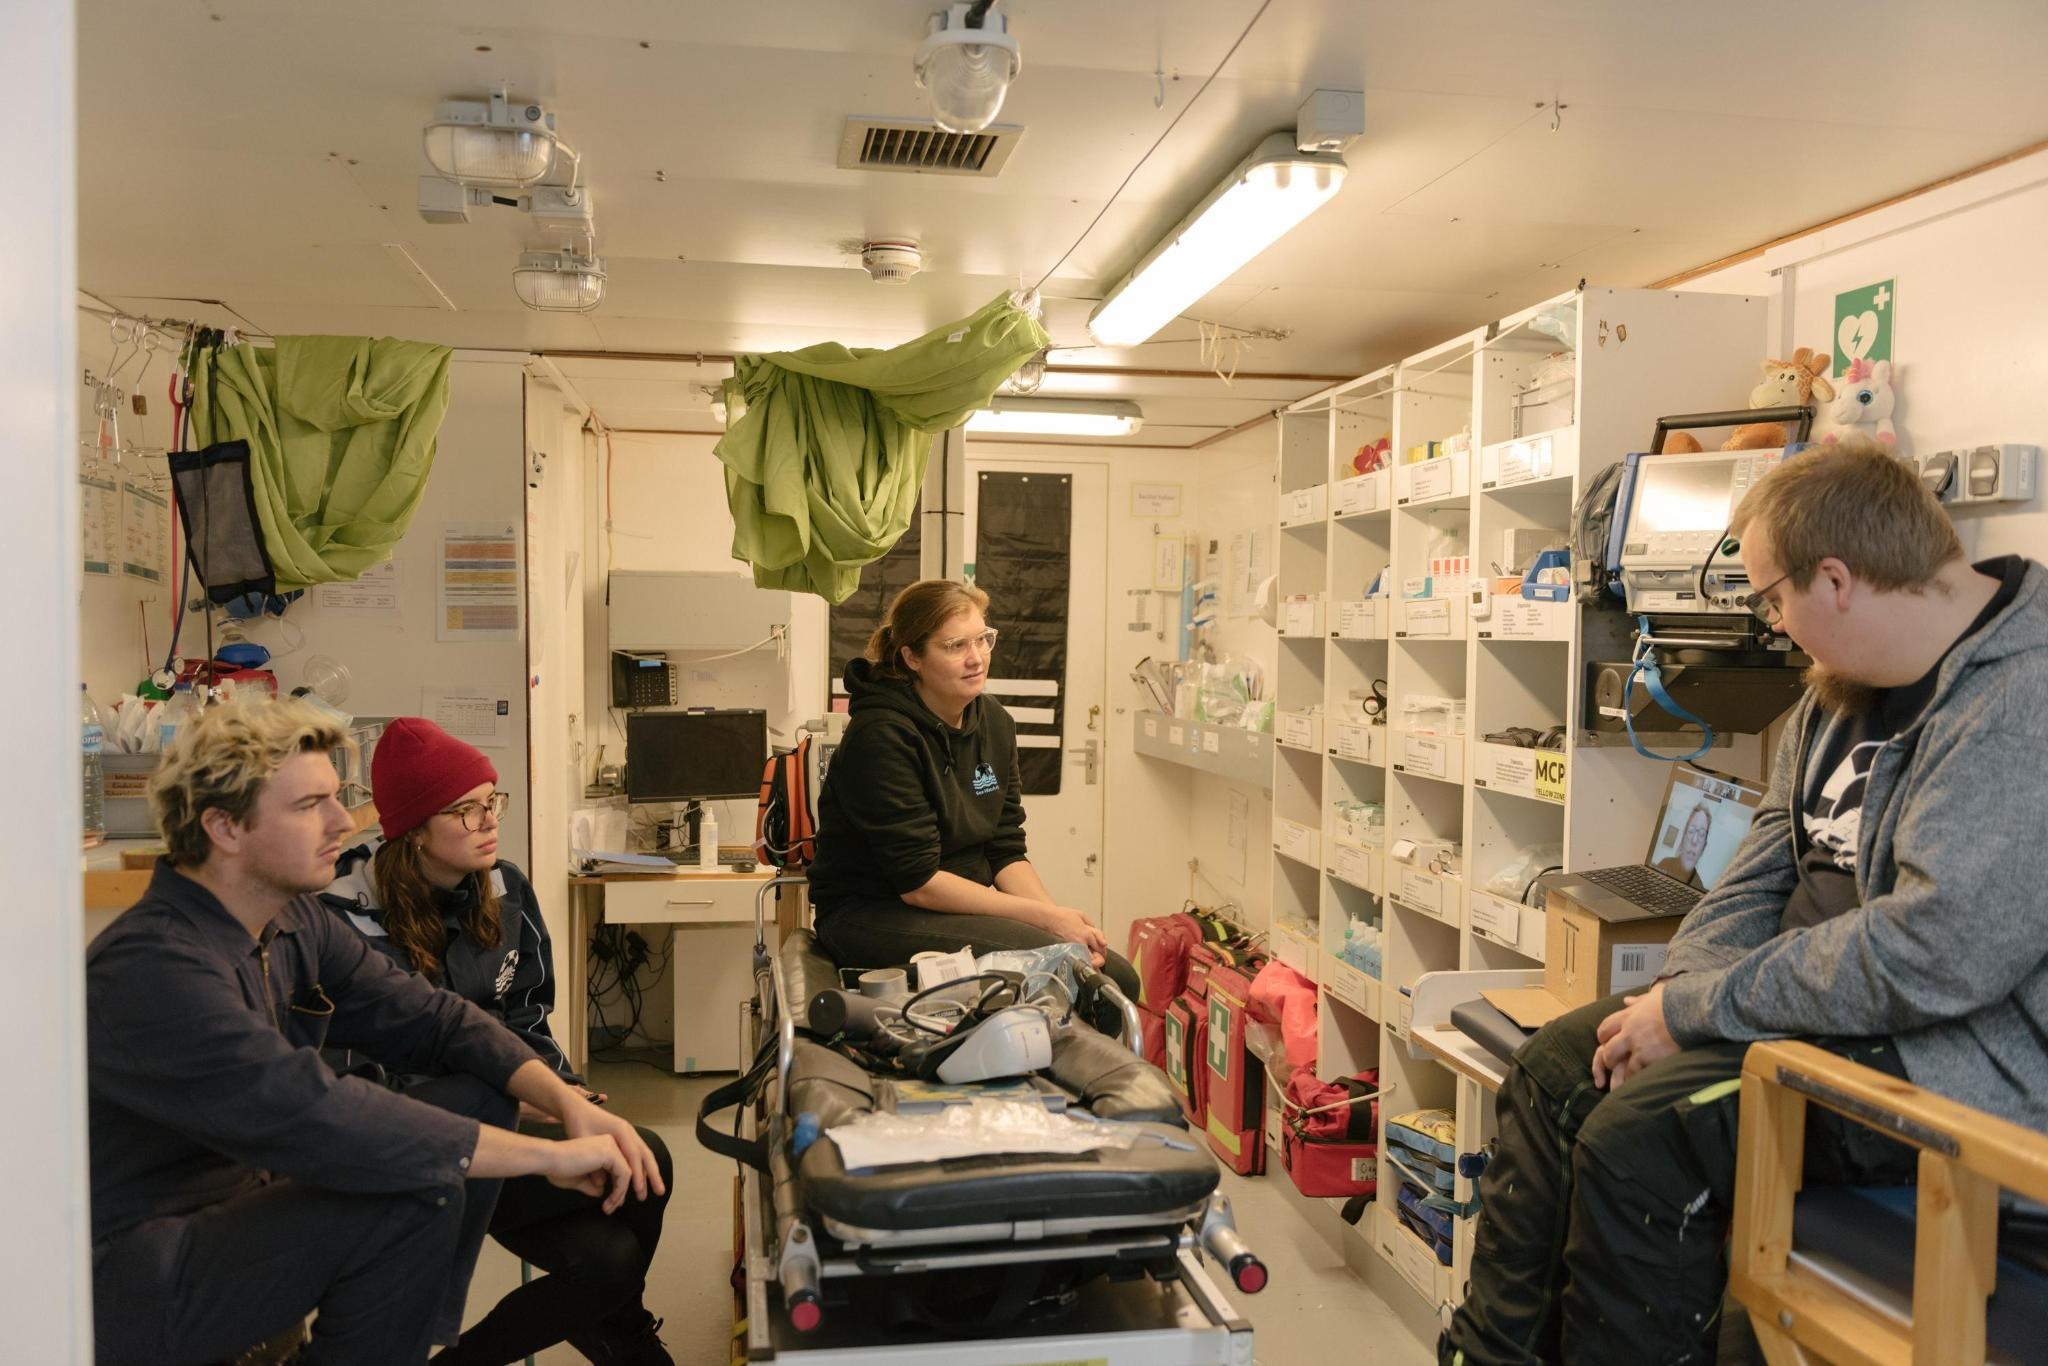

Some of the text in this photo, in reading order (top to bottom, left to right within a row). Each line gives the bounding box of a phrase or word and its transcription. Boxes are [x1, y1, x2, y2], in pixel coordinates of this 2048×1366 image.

[1536, 759, 1565, 784] MCP
[1536, 788, 1566, 801] YELLOW ZONE
